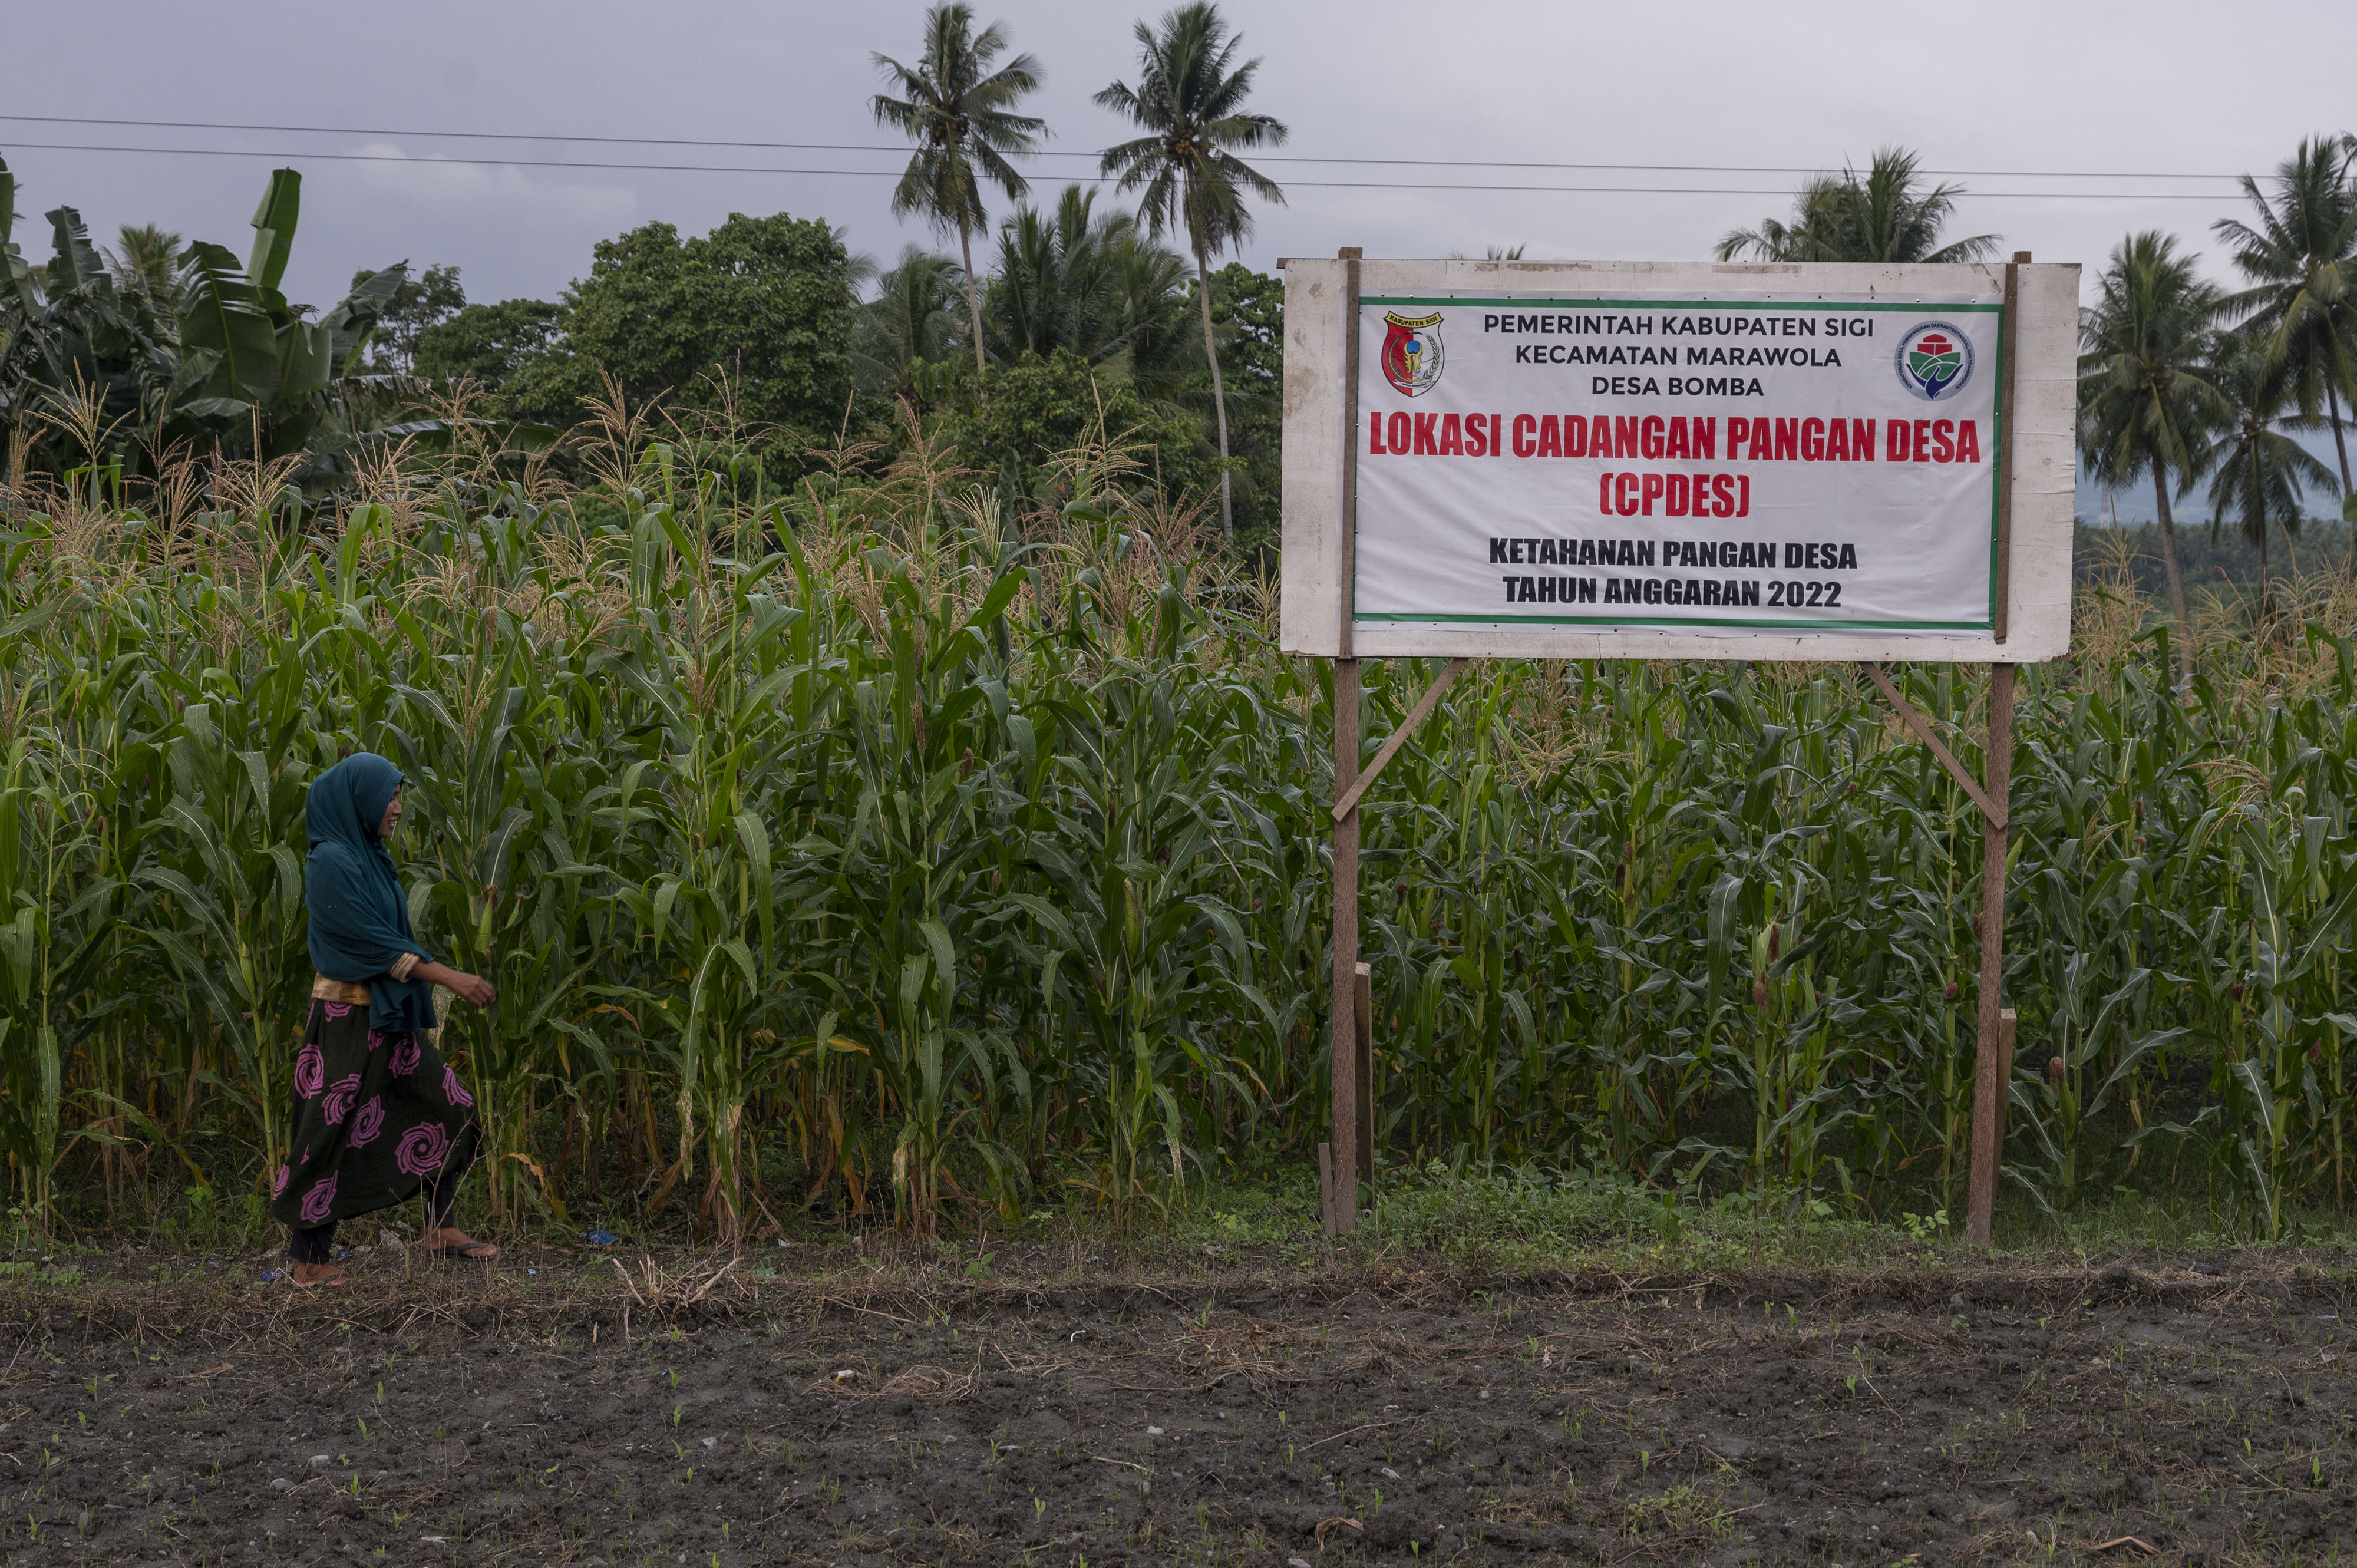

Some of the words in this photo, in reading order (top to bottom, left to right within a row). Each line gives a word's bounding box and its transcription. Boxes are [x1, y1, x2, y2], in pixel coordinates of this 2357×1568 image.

[1389, 315, 1424, 326] KABUPATEN
[1485, 315, 1652, 335] PEMERINTAH
[1663, 318, 1816, 336] KABUPATEN
[1826, 319, 1873, 337] SIGI
[1903, 324, 1930, 346] PEMBANGUNAN
[1517, 346, 1678, 365] KECAMATAN
[1688, 348, 1842, 367] MARAWOLA
[1593, 377, 1661, 395] DESA
[1669, 378, 1764, 397] BOMBA
[1897, 360, 1913, 389] KEMENTERIAN
[1956, 359, 1972, 389] TRANSMIGRASI
[1371, 412, 1501, 457] LOKASI
[1513, 415, 1716, 460] CADANGAN
[1728, 418, 1876, 461] PANGAN
[1887, 420, 1980, 463] DESA
[1601, 473, 1750, 518] (CPDES)
[1491, 539, 1655, 566] KETAHANAN
[1664, 542, 1777, 568] PANGAN
[1785, 544, 1857, 570] DESA
[1504, 577, 1597, 603] TAHUN
[1605, 579, 1760, 606] ANGGARAN
[1768, 582, 1842, 608] 2022
